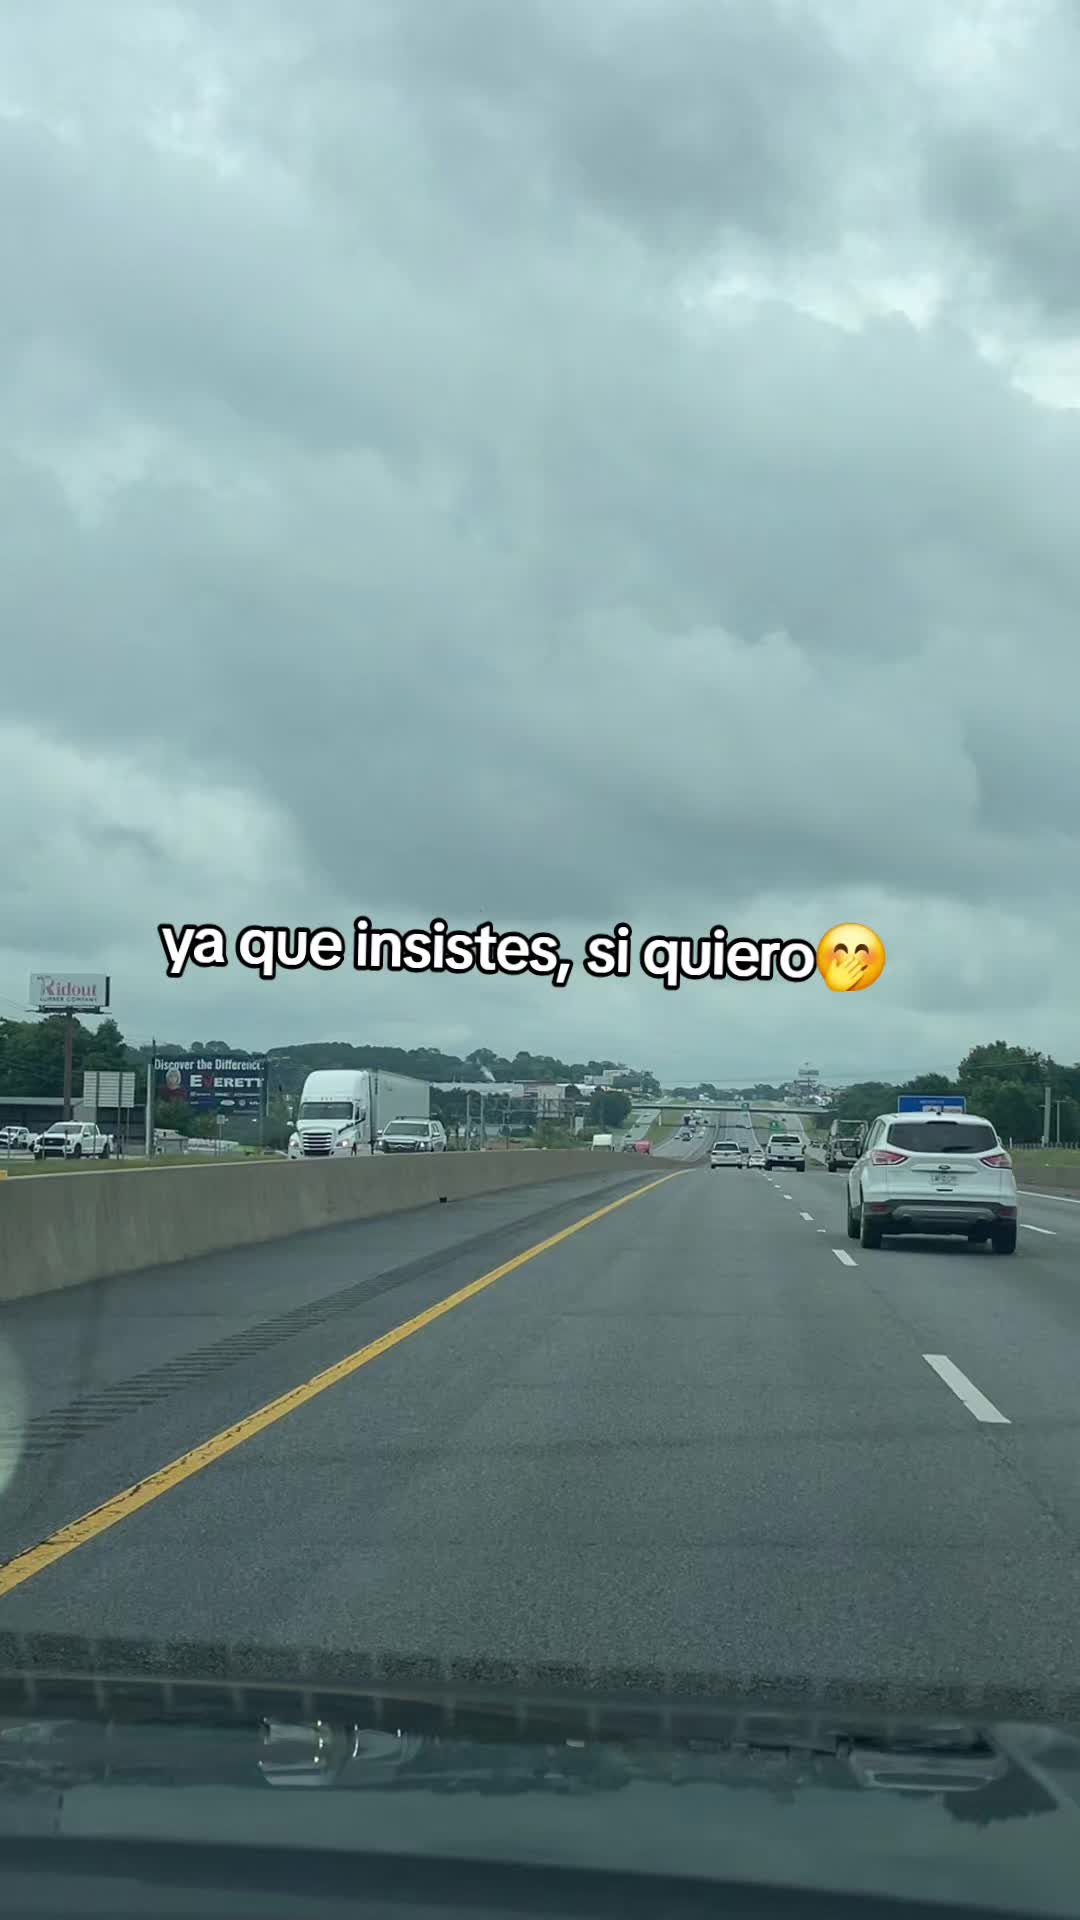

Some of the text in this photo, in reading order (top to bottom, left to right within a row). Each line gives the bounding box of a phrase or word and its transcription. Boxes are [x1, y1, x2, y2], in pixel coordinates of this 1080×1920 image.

[37, 975, 97, 997] Ridout
[154, 1058, 195, 1070] Discover
[197, 1058, 213, 1070] the
